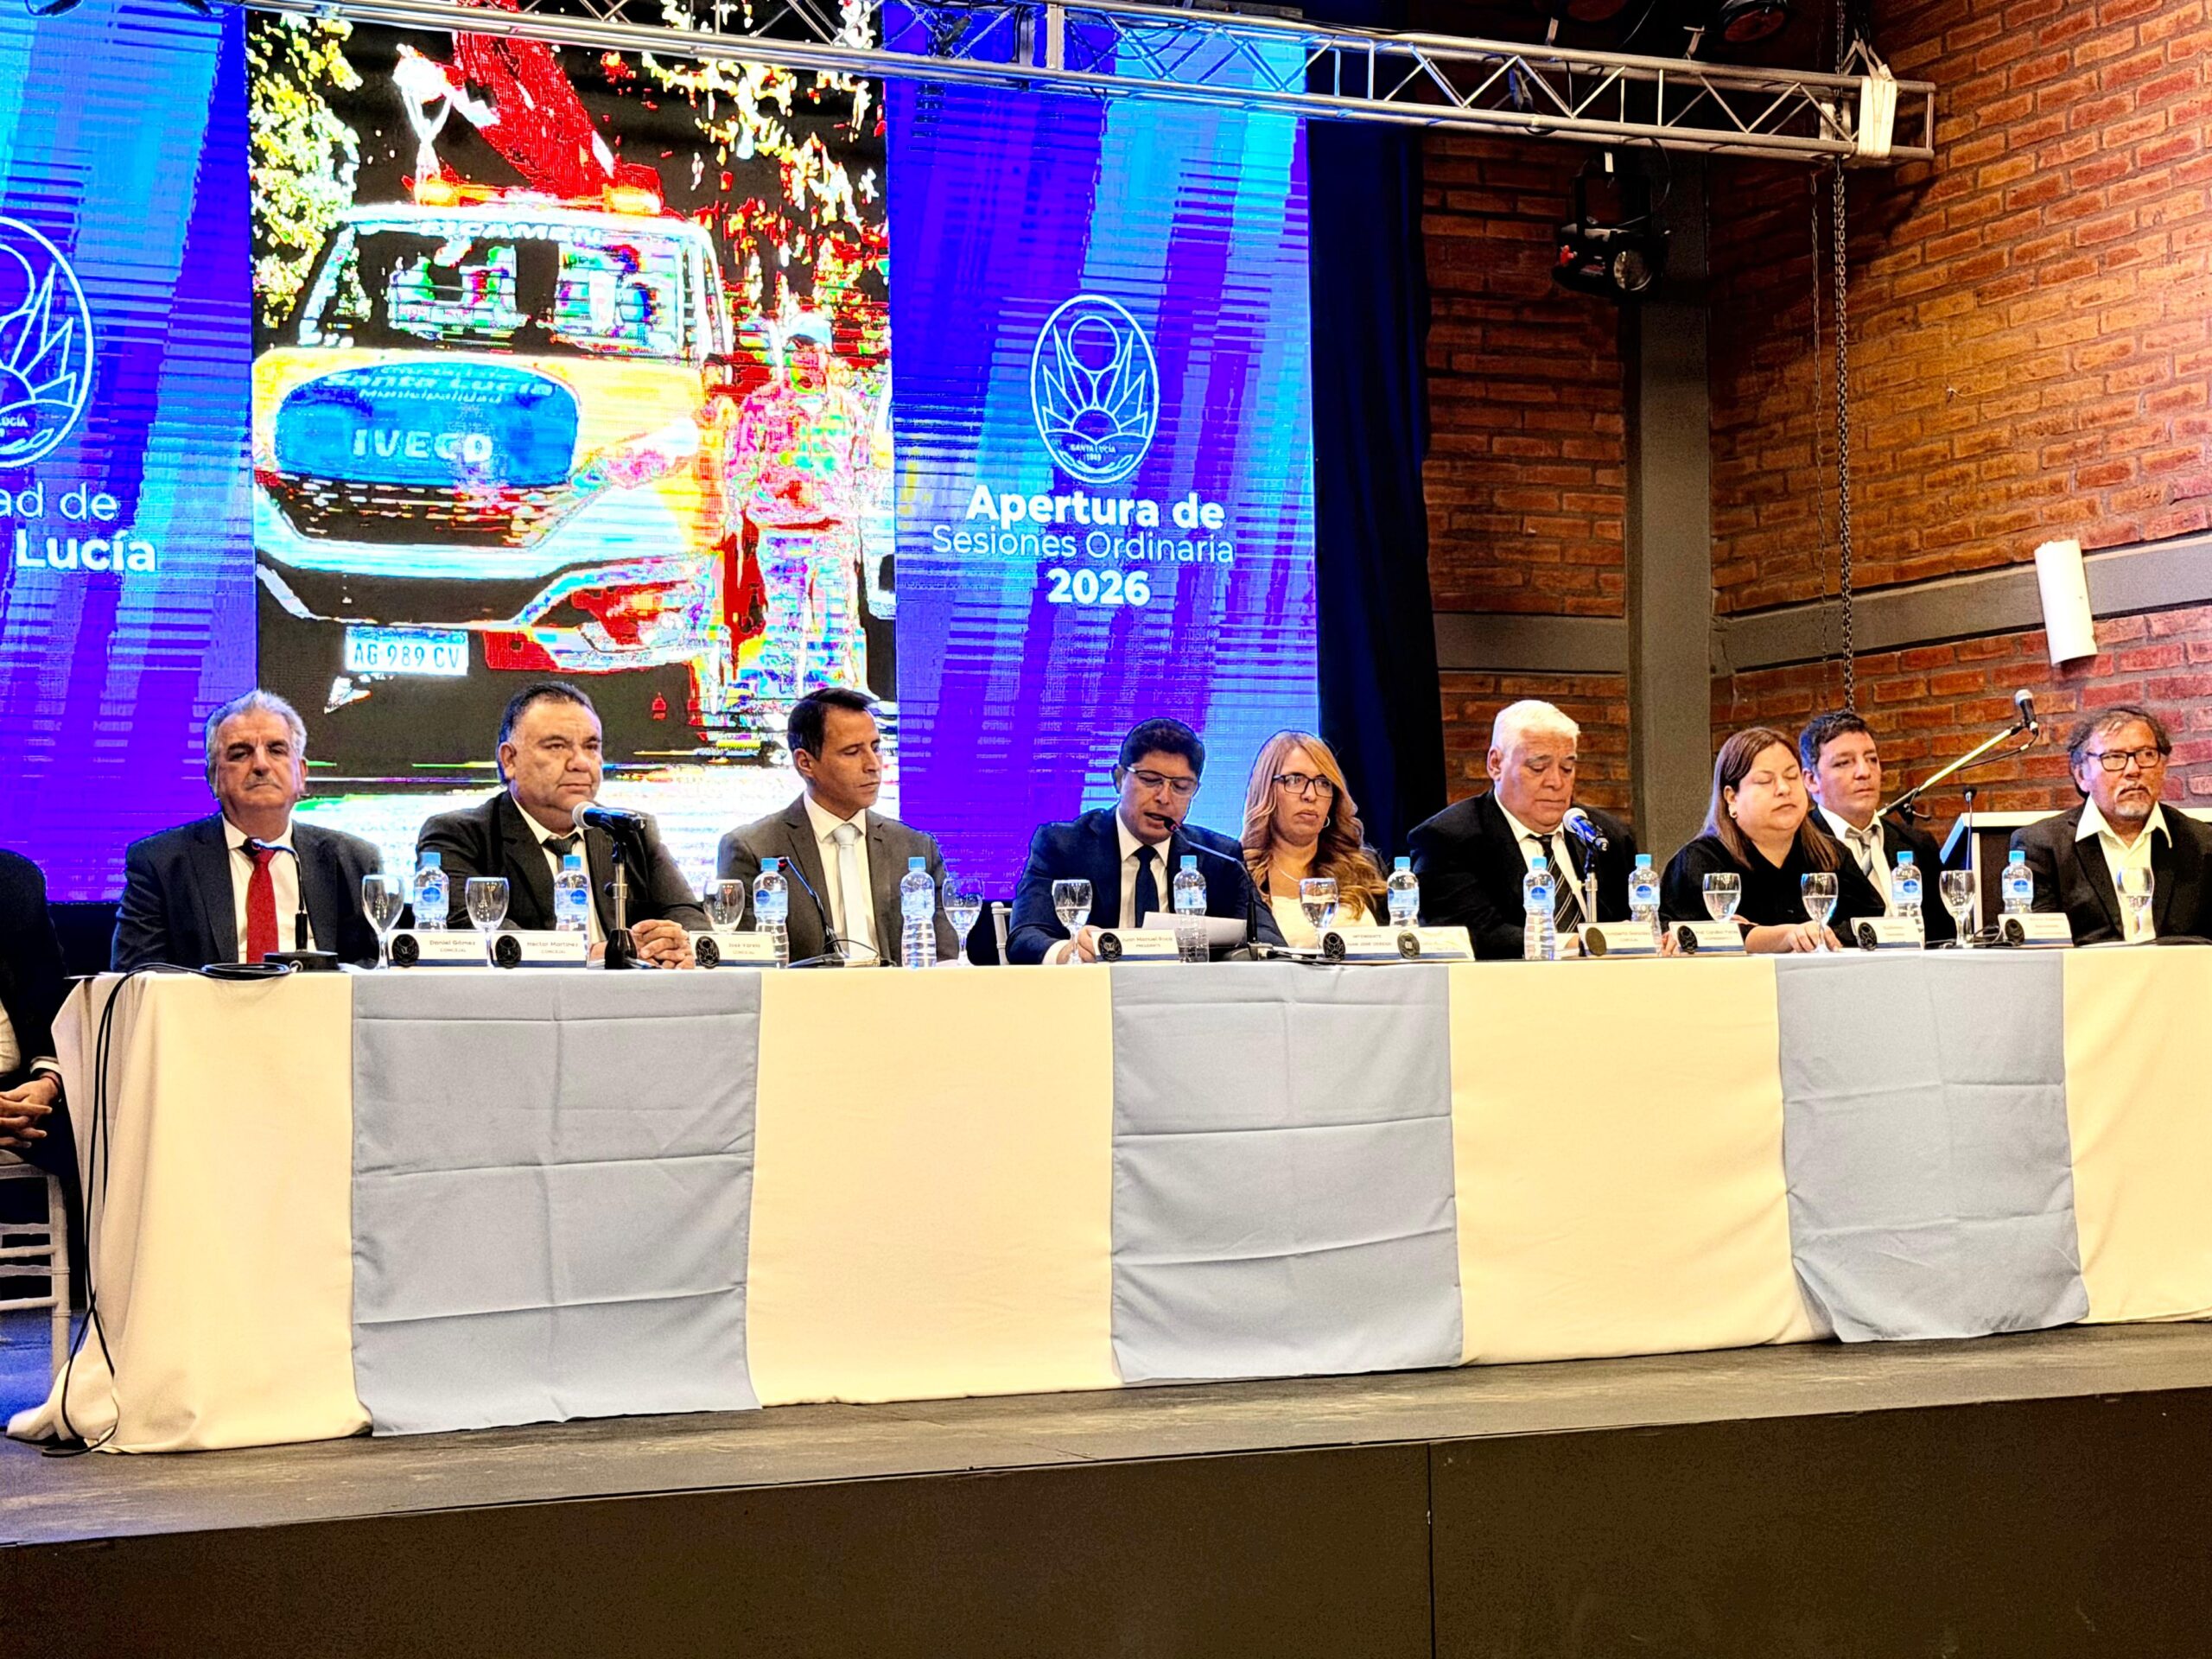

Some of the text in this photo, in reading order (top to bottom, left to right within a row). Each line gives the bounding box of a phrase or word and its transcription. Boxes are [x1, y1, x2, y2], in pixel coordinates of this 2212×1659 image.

[352, 428, 493, 463] IVECO
[60, 481, 119, 521] de
[965, 484, 1225, 530] Apertura de
[16, 528, 156, 573] Lucía
[931, 524, 1235, 563] Sesiones Ordinaria
[1046, 567, 1151, 606] 2026
[354, 642, 460, 668] AG 989 CV
